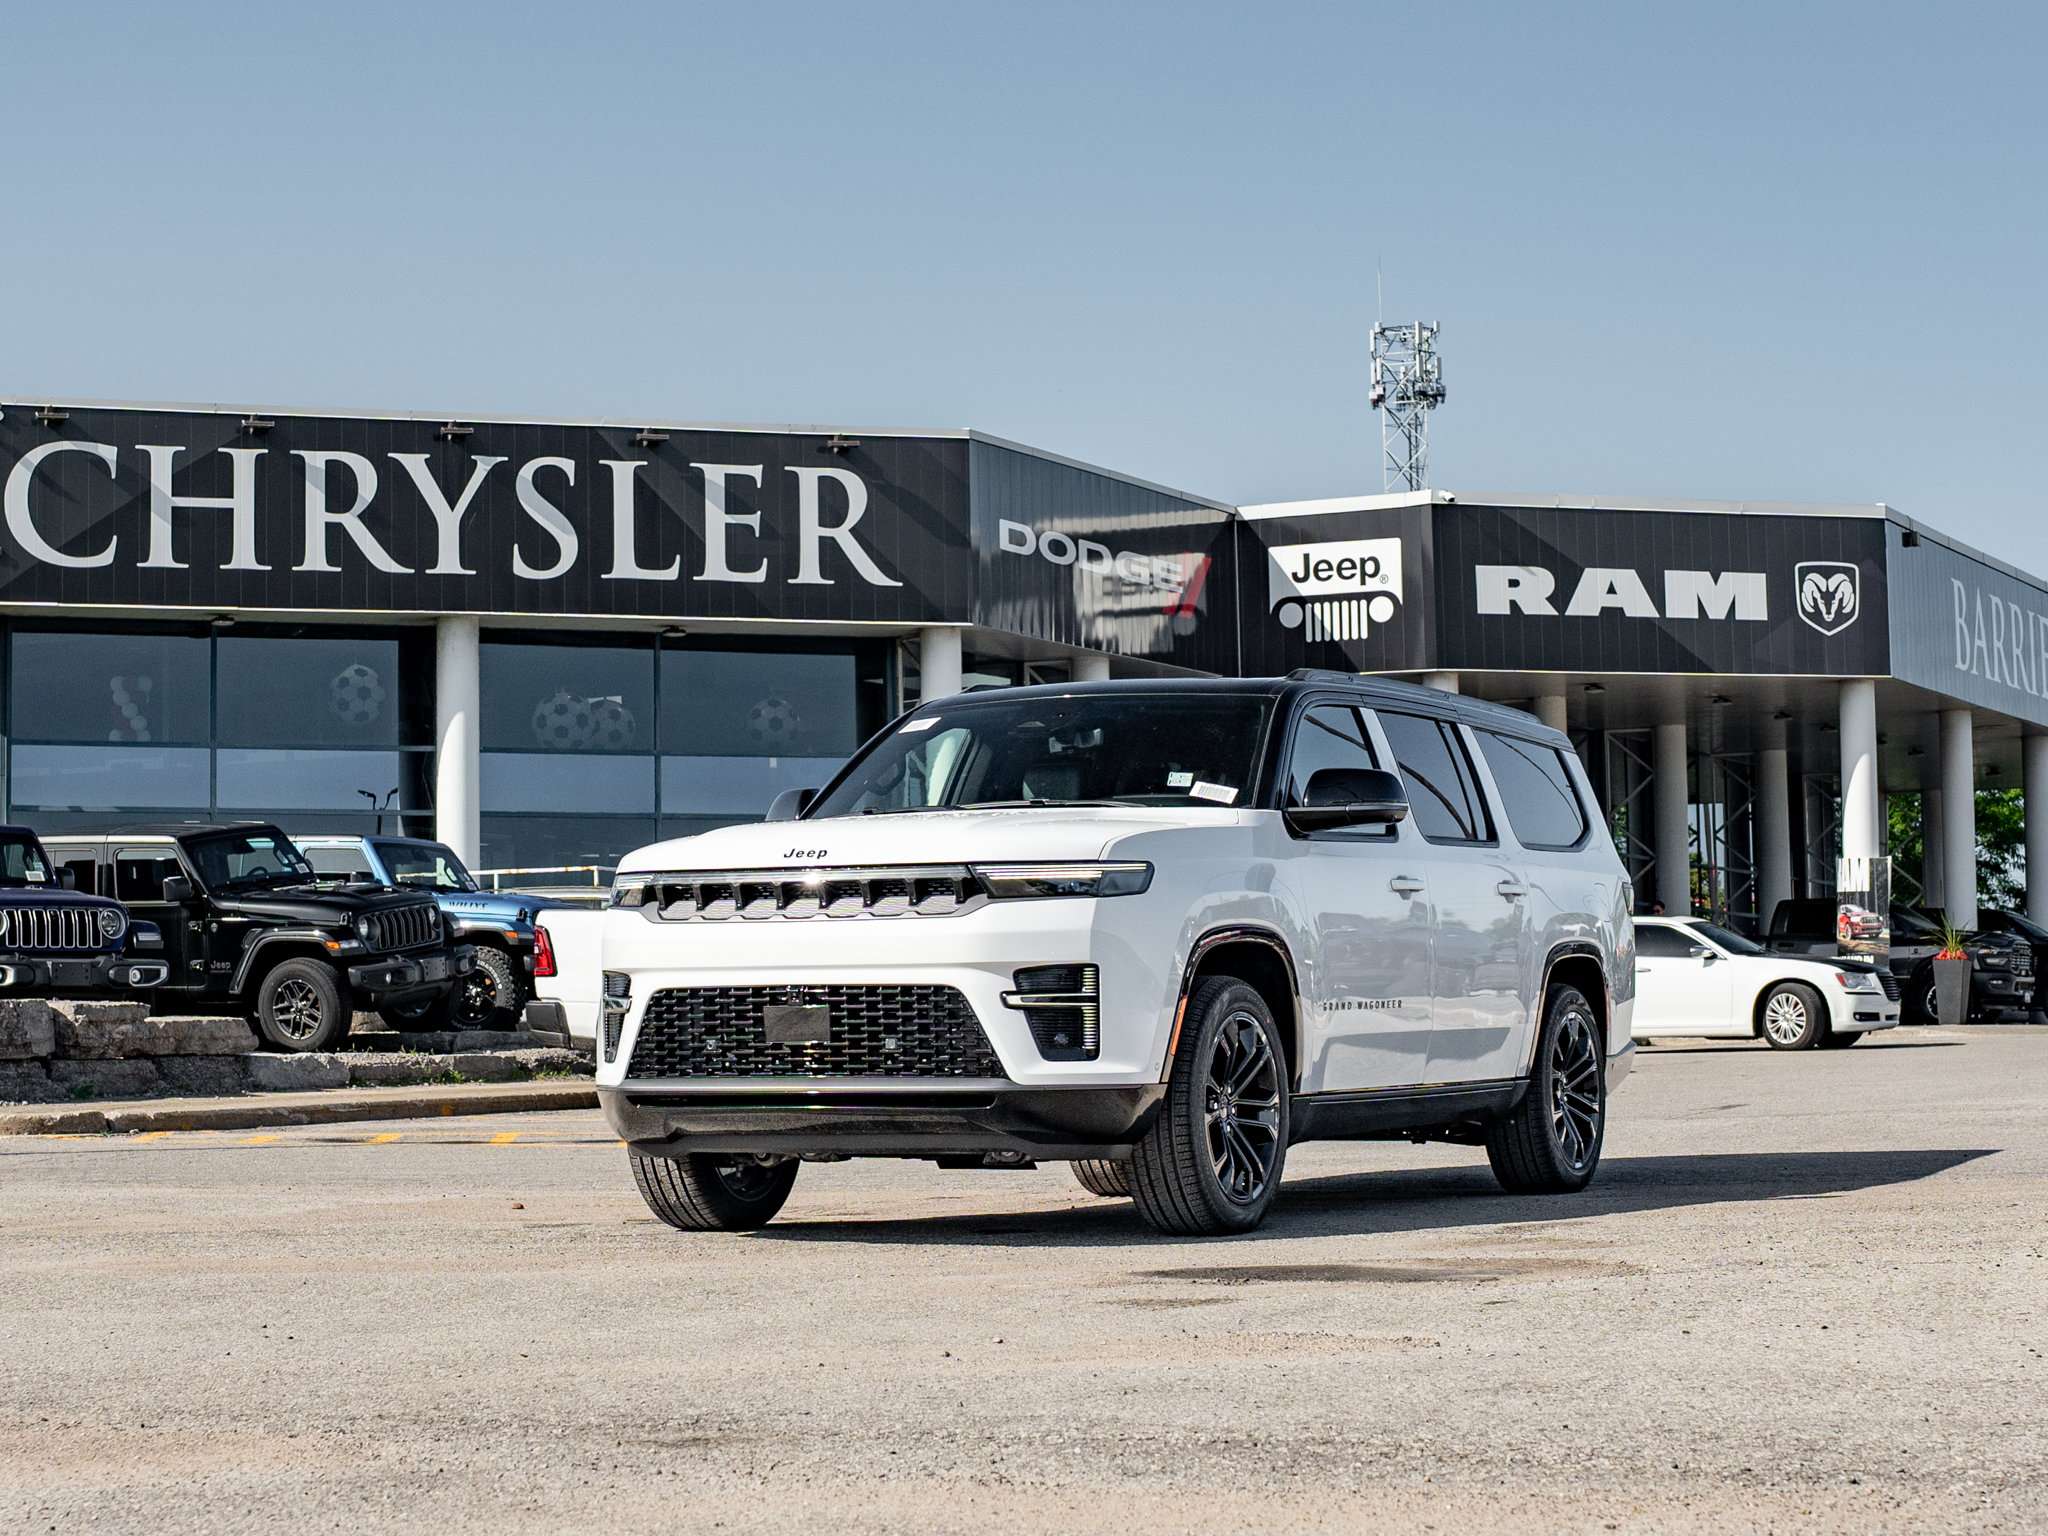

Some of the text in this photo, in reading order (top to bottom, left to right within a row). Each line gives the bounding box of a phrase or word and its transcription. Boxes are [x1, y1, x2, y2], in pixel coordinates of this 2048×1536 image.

[4, 441, 903, 586] CHRYSLER
[999, 518, 1184, 594] DODGE
[1291, 552, 1381, 586] Jeep
[1475, 564, 1768, 621] RAM
[783, 848, 828, 860] Jeep
[1323, 1000, 1402, 1012] GRAND WAGONEER
